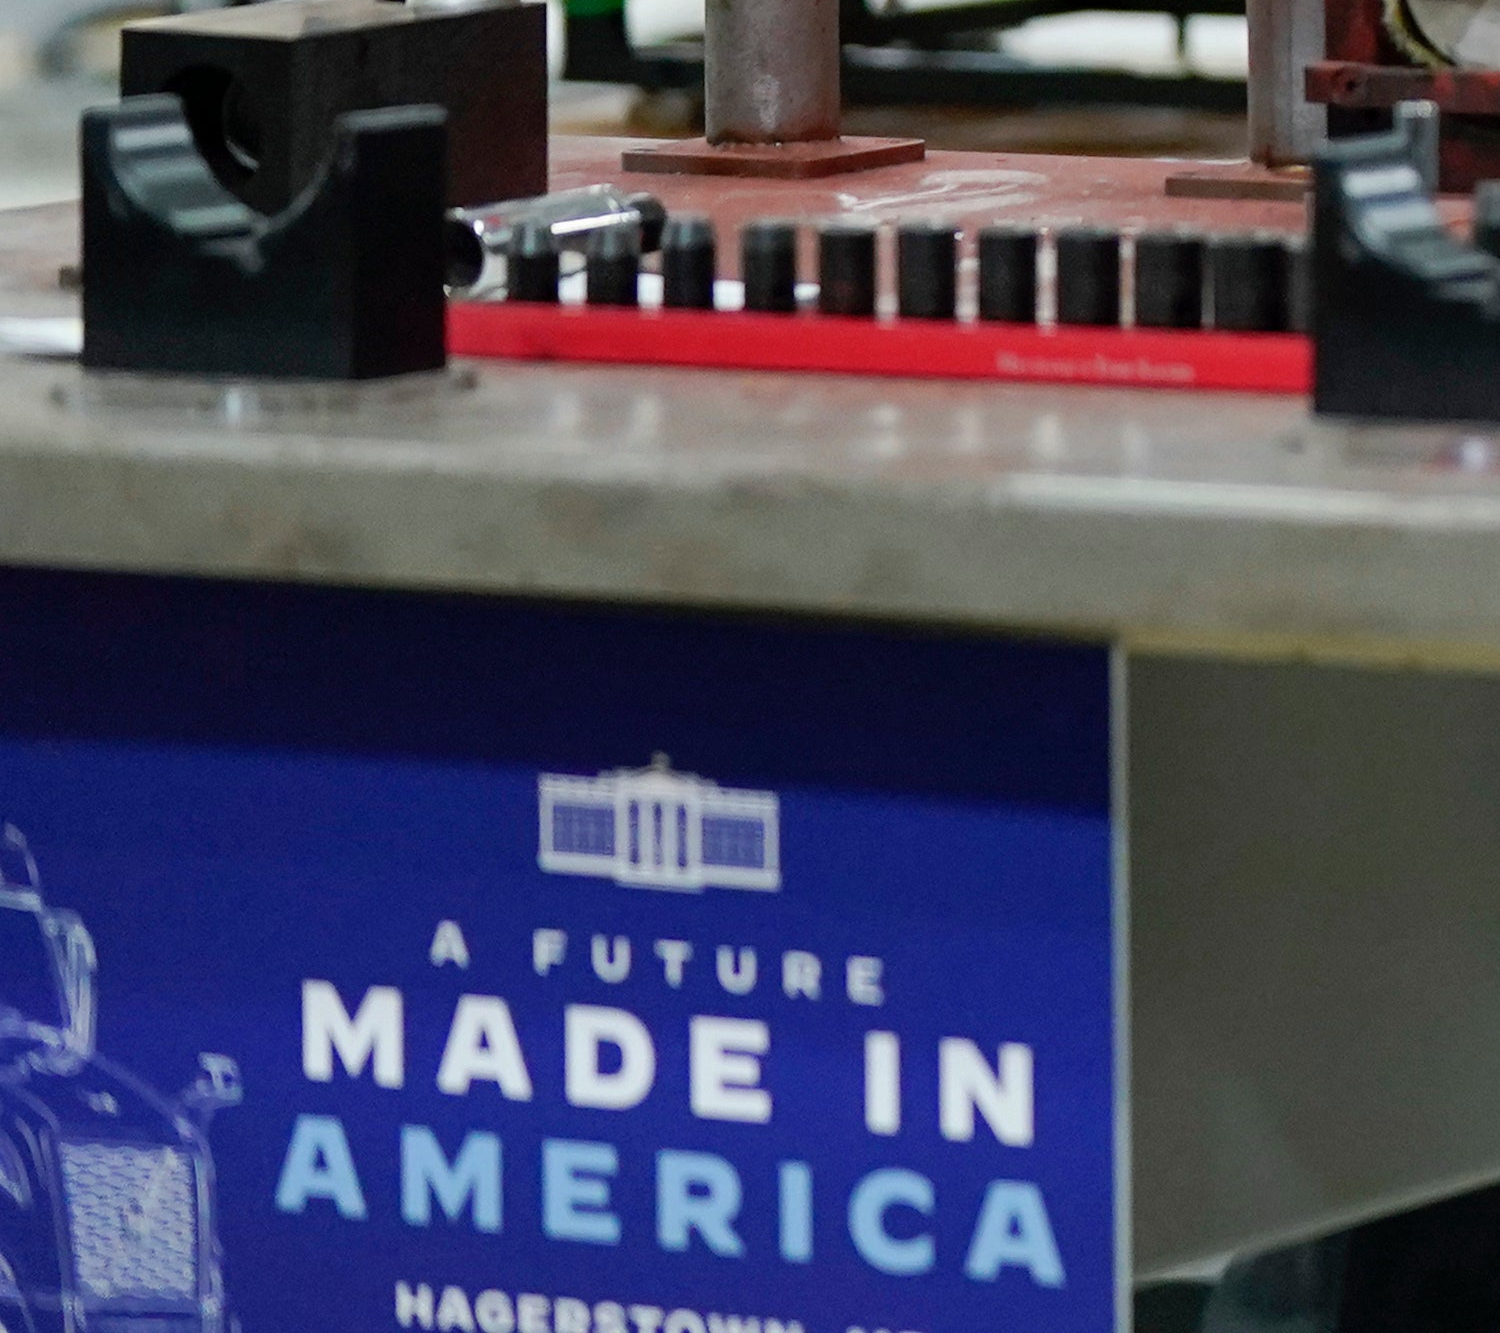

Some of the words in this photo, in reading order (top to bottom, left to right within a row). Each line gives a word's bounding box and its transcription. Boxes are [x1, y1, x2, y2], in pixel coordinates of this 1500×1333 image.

[430, 919, 469, 969] A
[533, 928, 884, 1008] FUTURE
[302, 979, 772, 1123] MADE
[865, 1031, 1034, 1148] IN
[275, 1114, 1065, 1288] AMERICA
